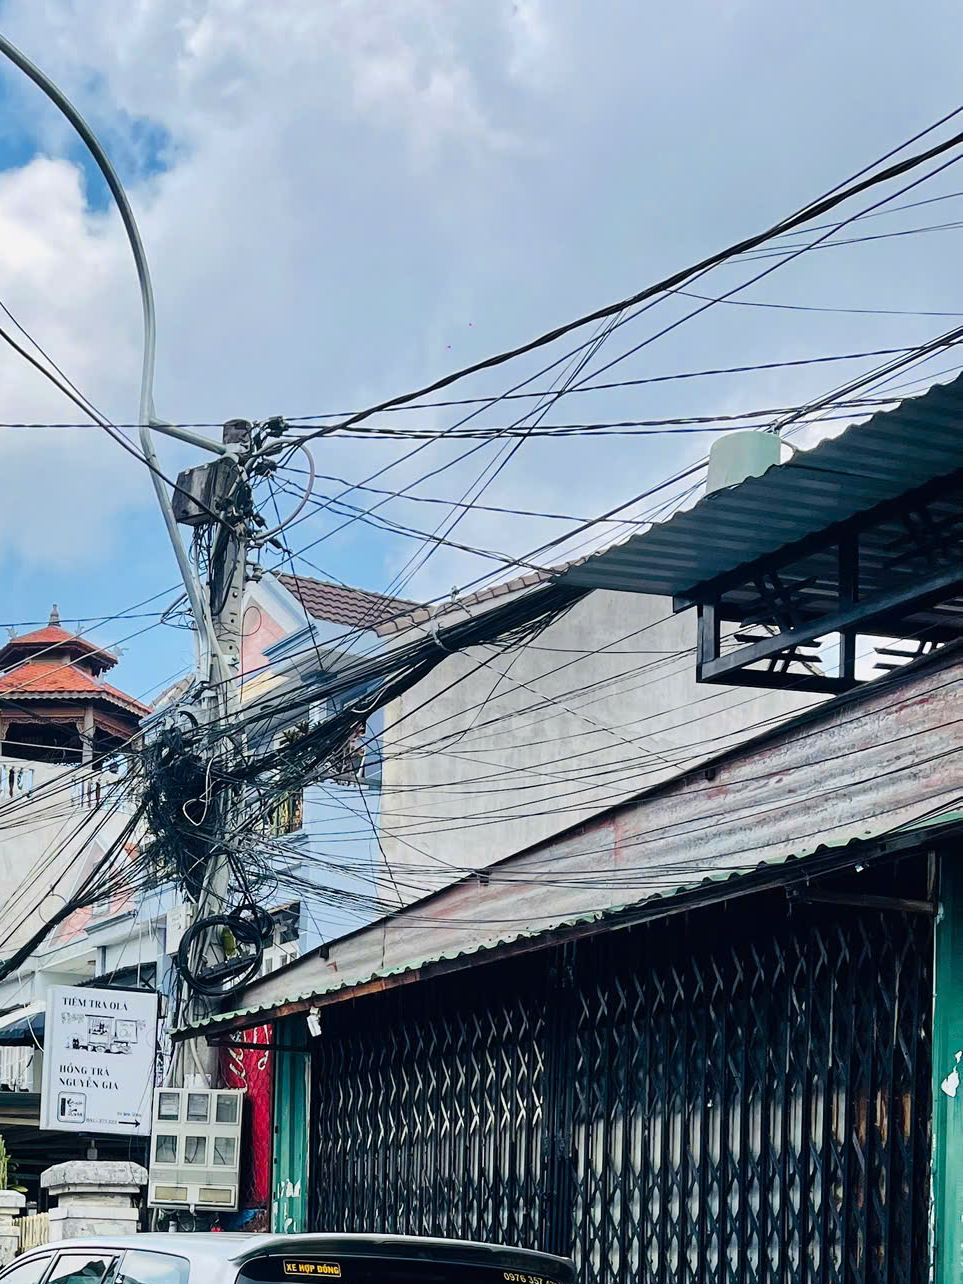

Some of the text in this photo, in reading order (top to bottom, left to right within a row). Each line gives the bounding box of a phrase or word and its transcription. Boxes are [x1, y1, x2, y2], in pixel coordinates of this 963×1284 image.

[101, 1081, 119, 1090] GIA
[286, 1263, 297, 1272] XE
[503, 1272, 526, 1283] 0976
